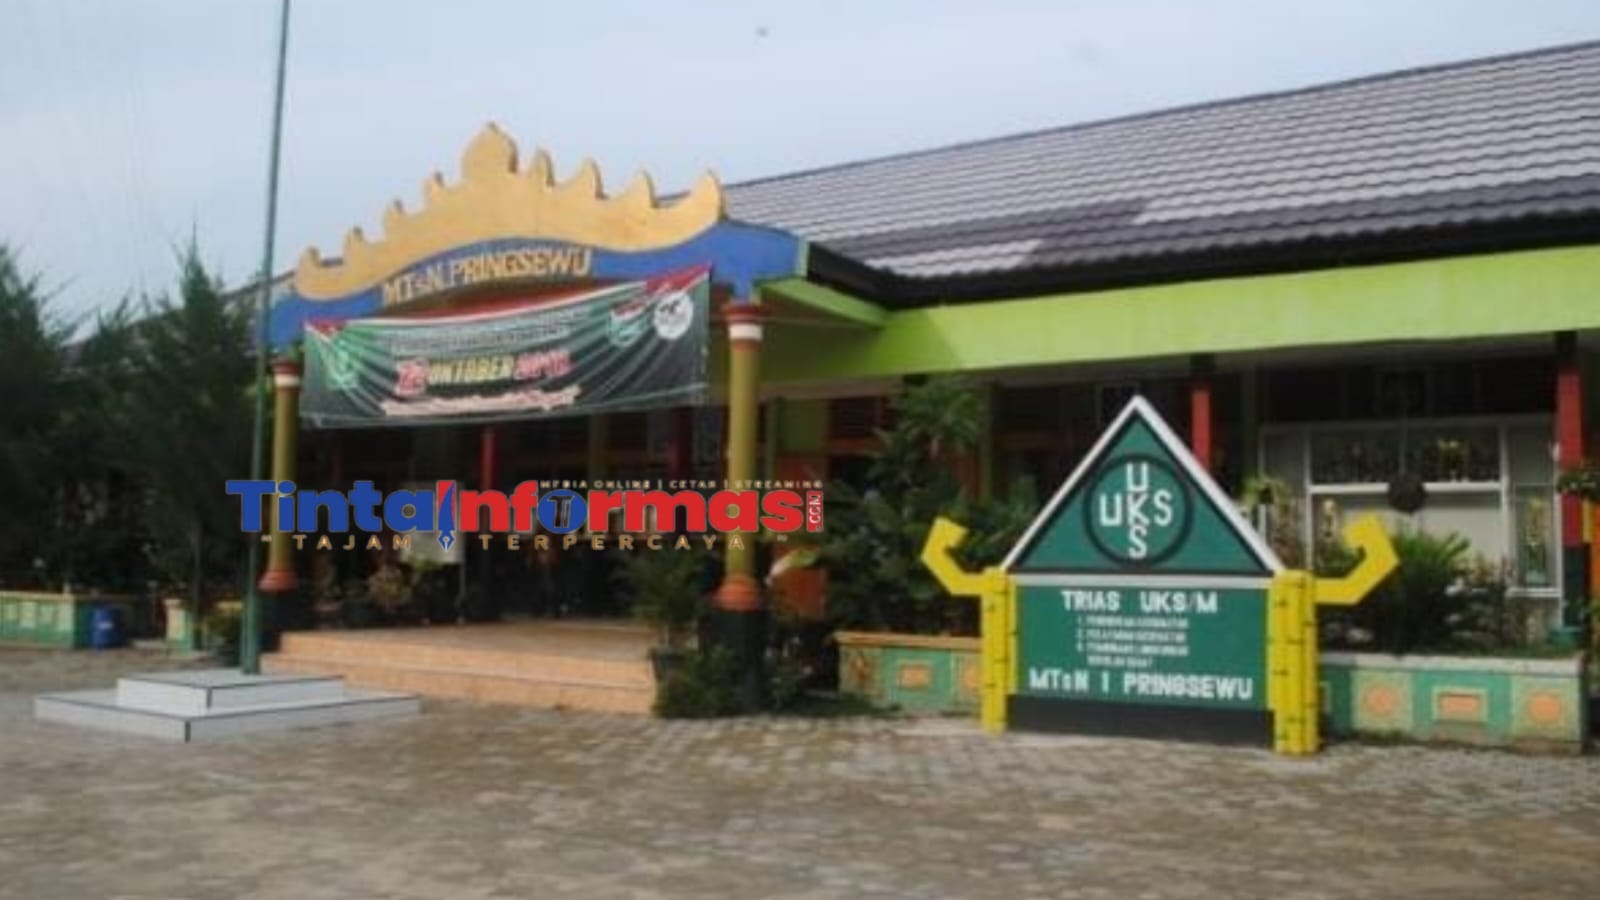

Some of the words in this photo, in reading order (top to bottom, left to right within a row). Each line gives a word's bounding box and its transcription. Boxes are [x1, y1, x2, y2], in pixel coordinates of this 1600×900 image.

[450, 247, 591, 287] PRINGSEWU
[1100, 488, 1173, 528] UKS
[1062, 590, 1121, 612] TRIAS
[1029, 667, 1090, 692] MTsN
[1123, 671, 1254, 700] PRINGSEWU
